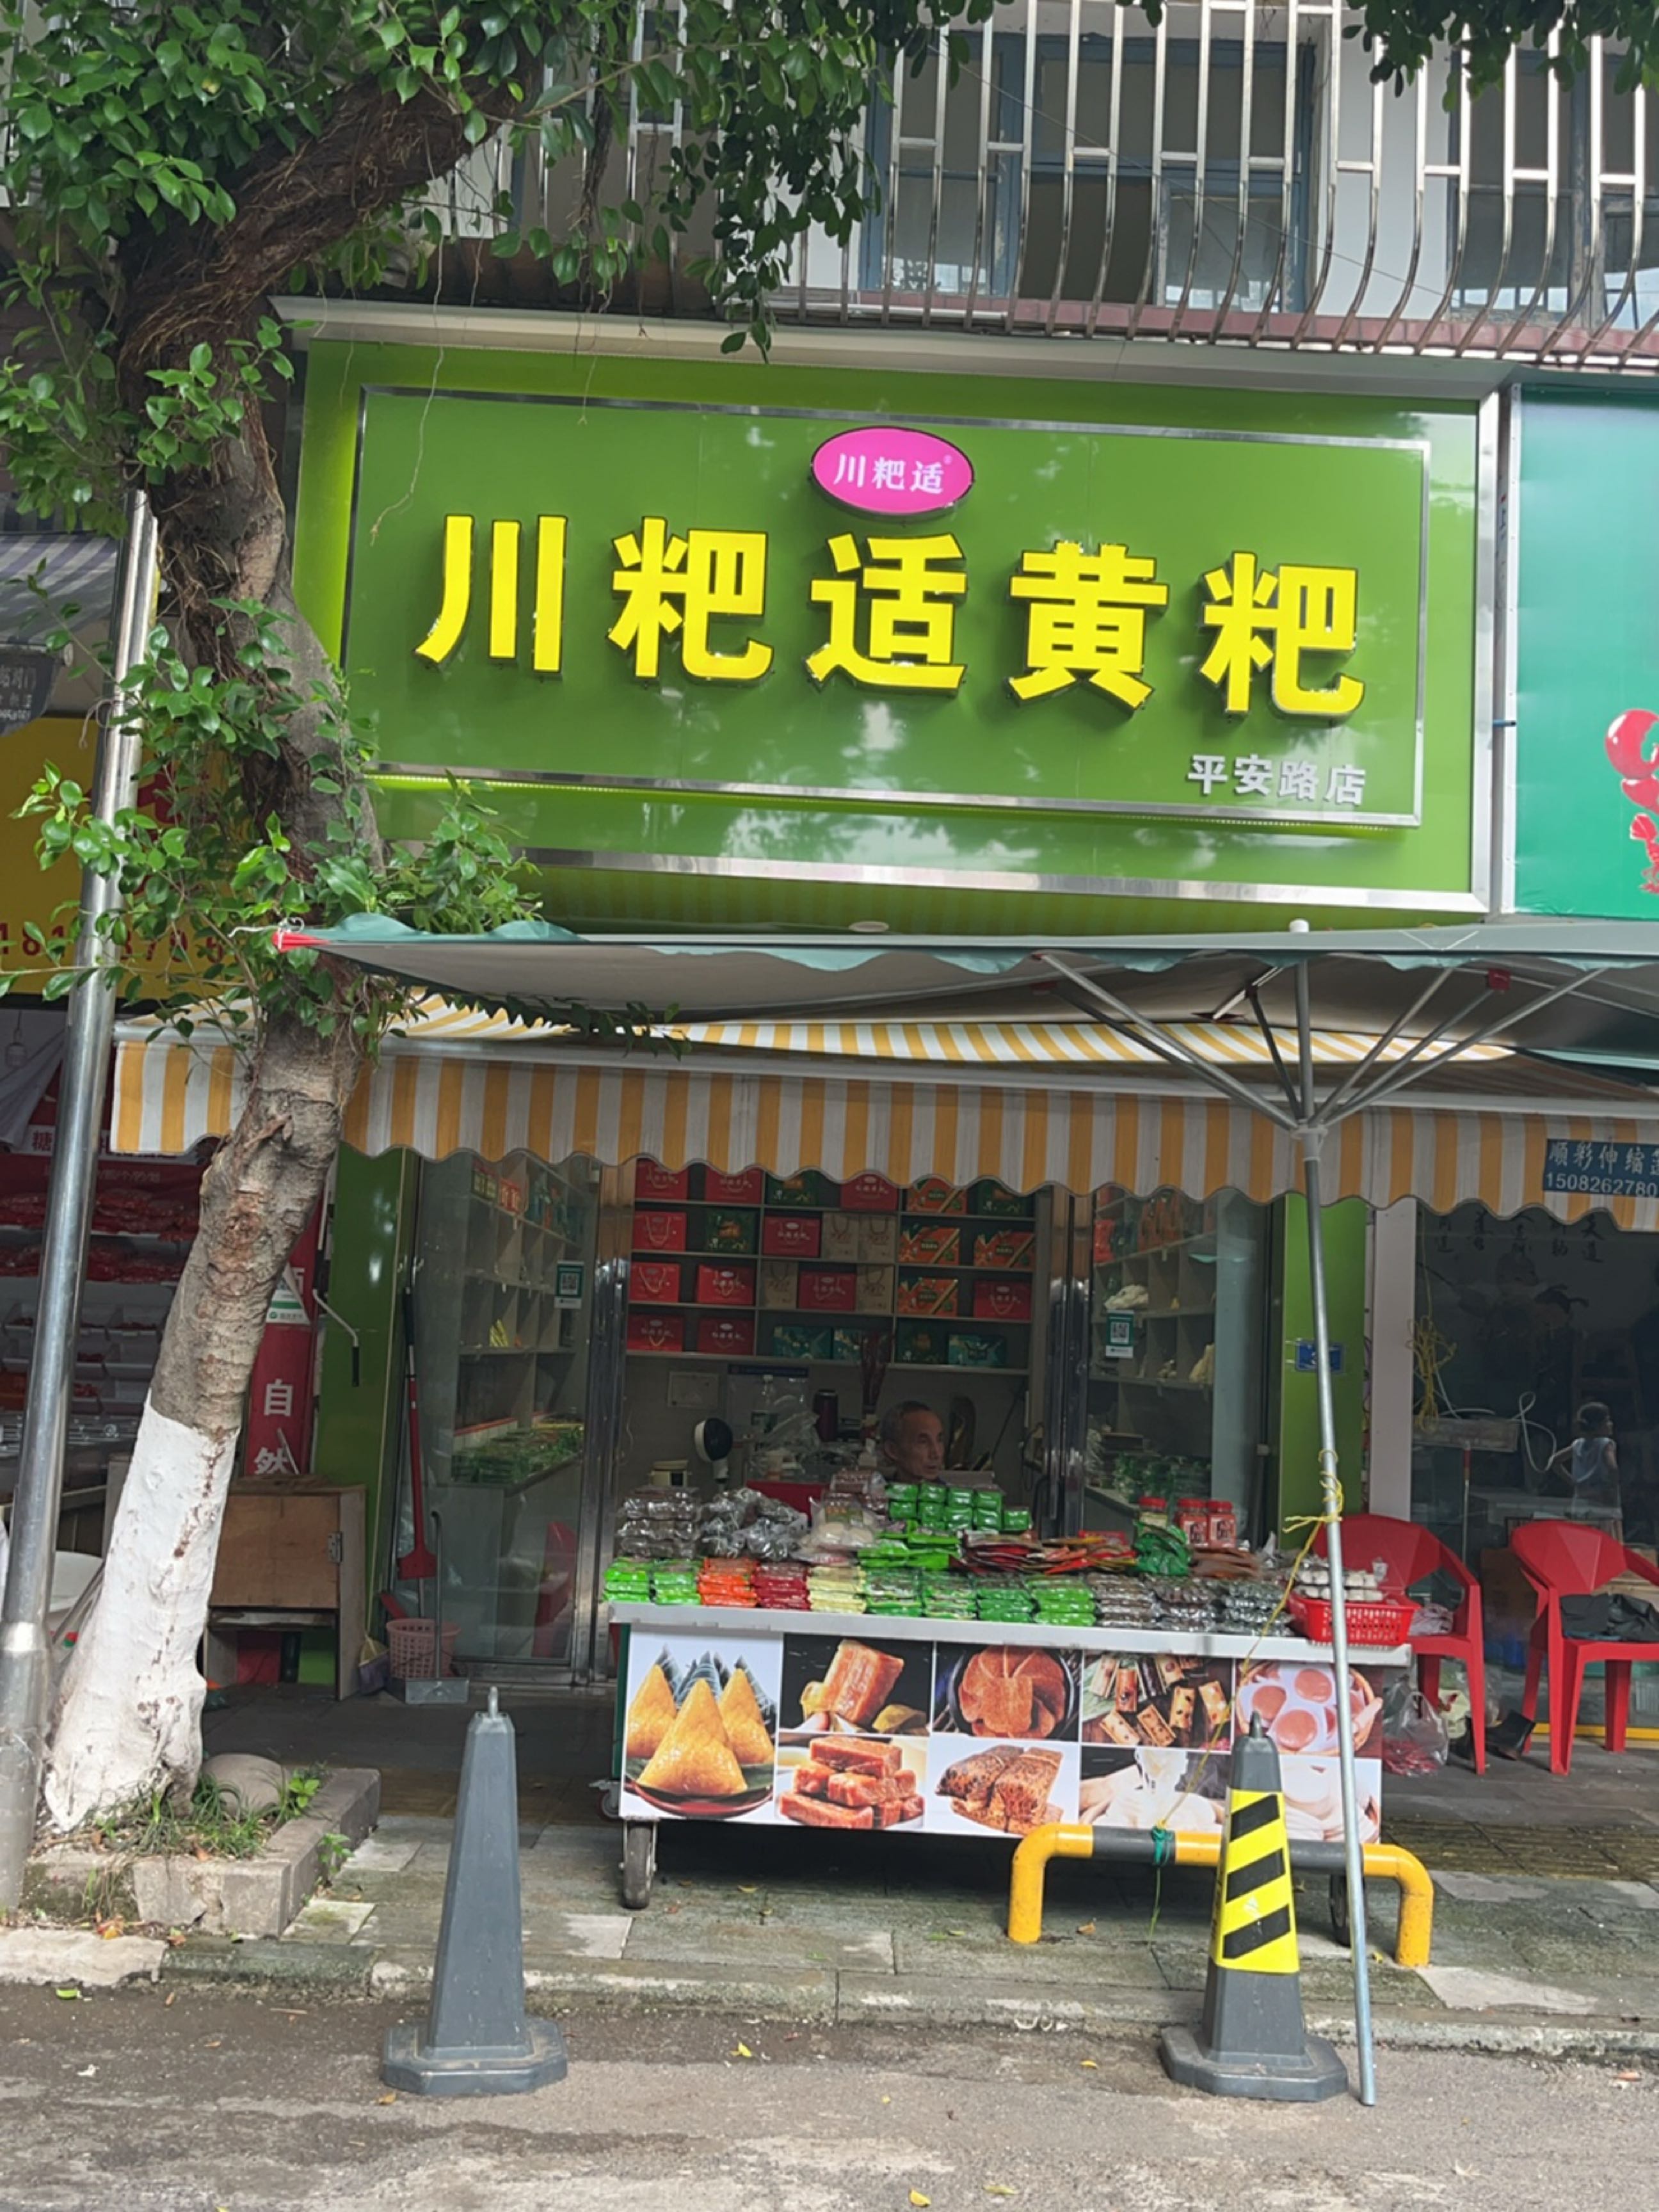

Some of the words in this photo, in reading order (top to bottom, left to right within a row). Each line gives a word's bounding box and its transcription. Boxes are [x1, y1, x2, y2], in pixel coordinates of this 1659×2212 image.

[833, 453, 945, 494] 川粑适
[419, 517, 1363, 712] 川粑适黄粑
[1187, 753, 1366, 806] 平安路店
